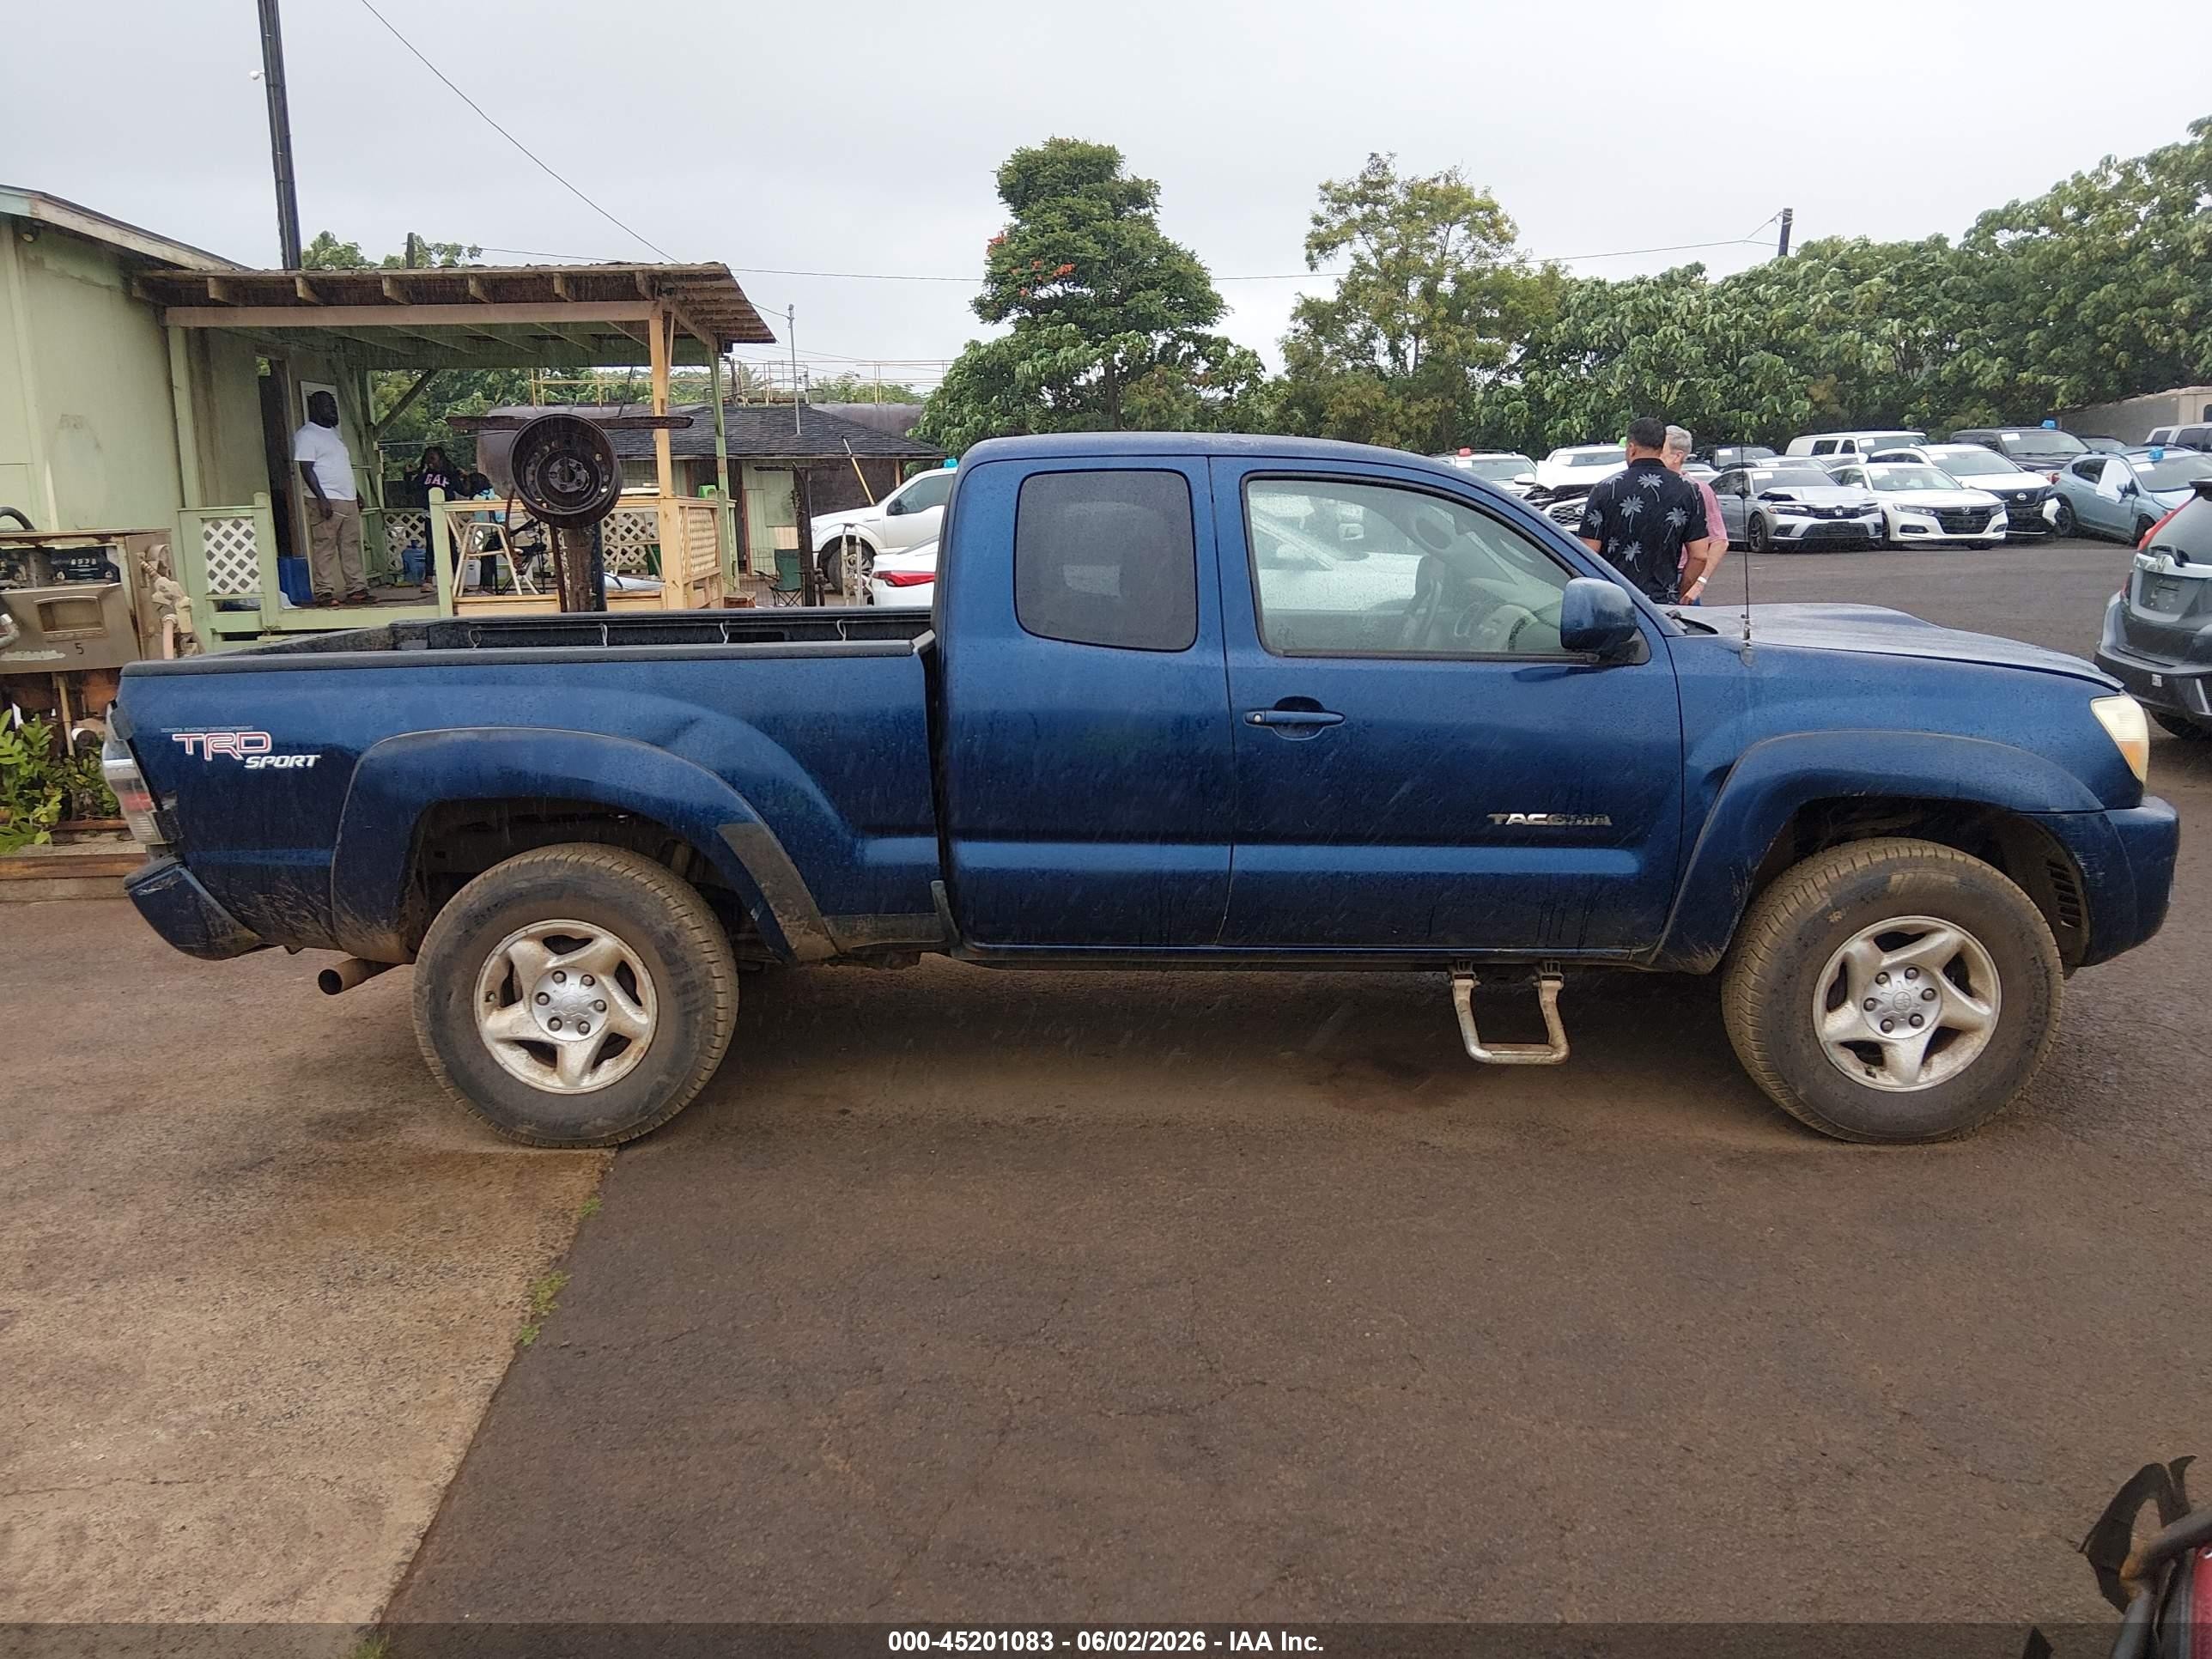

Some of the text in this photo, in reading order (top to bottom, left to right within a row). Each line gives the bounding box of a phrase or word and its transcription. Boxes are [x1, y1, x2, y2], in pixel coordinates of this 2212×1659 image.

[74, 642, 84, 654] 5
[172, 732, 272, 761] TRD
[244, 755, 321, 769] SPORT
